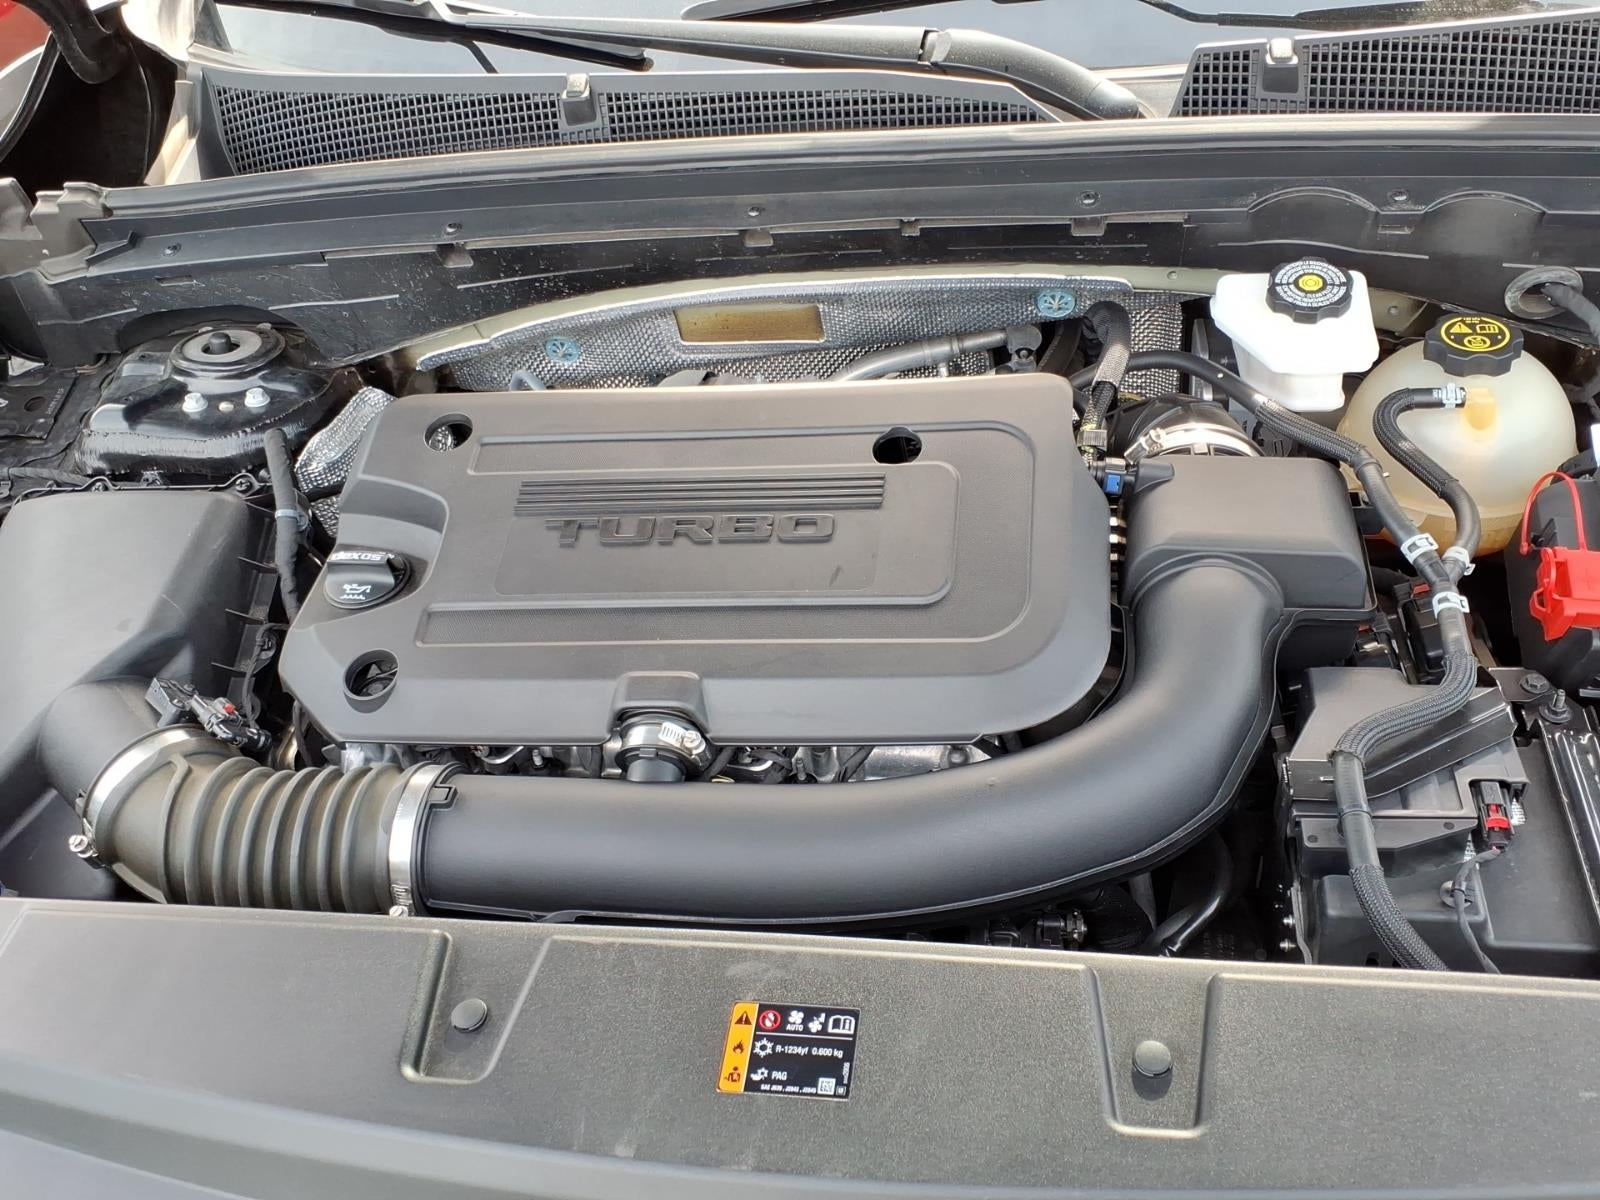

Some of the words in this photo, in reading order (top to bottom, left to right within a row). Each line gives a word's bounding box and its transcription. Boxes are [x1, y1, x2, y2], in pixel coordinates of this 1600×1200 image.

[544, 513, 836, 548] TURBO
[786, 1024, 804, 1032] AUTO
[775, 1045, 808, 1057] R-1234yf
[811, 1048, 832, 1057] 0.600
[833, 1048, 843, 1059] kg
[771, 1071, 787, 1081] PAG
